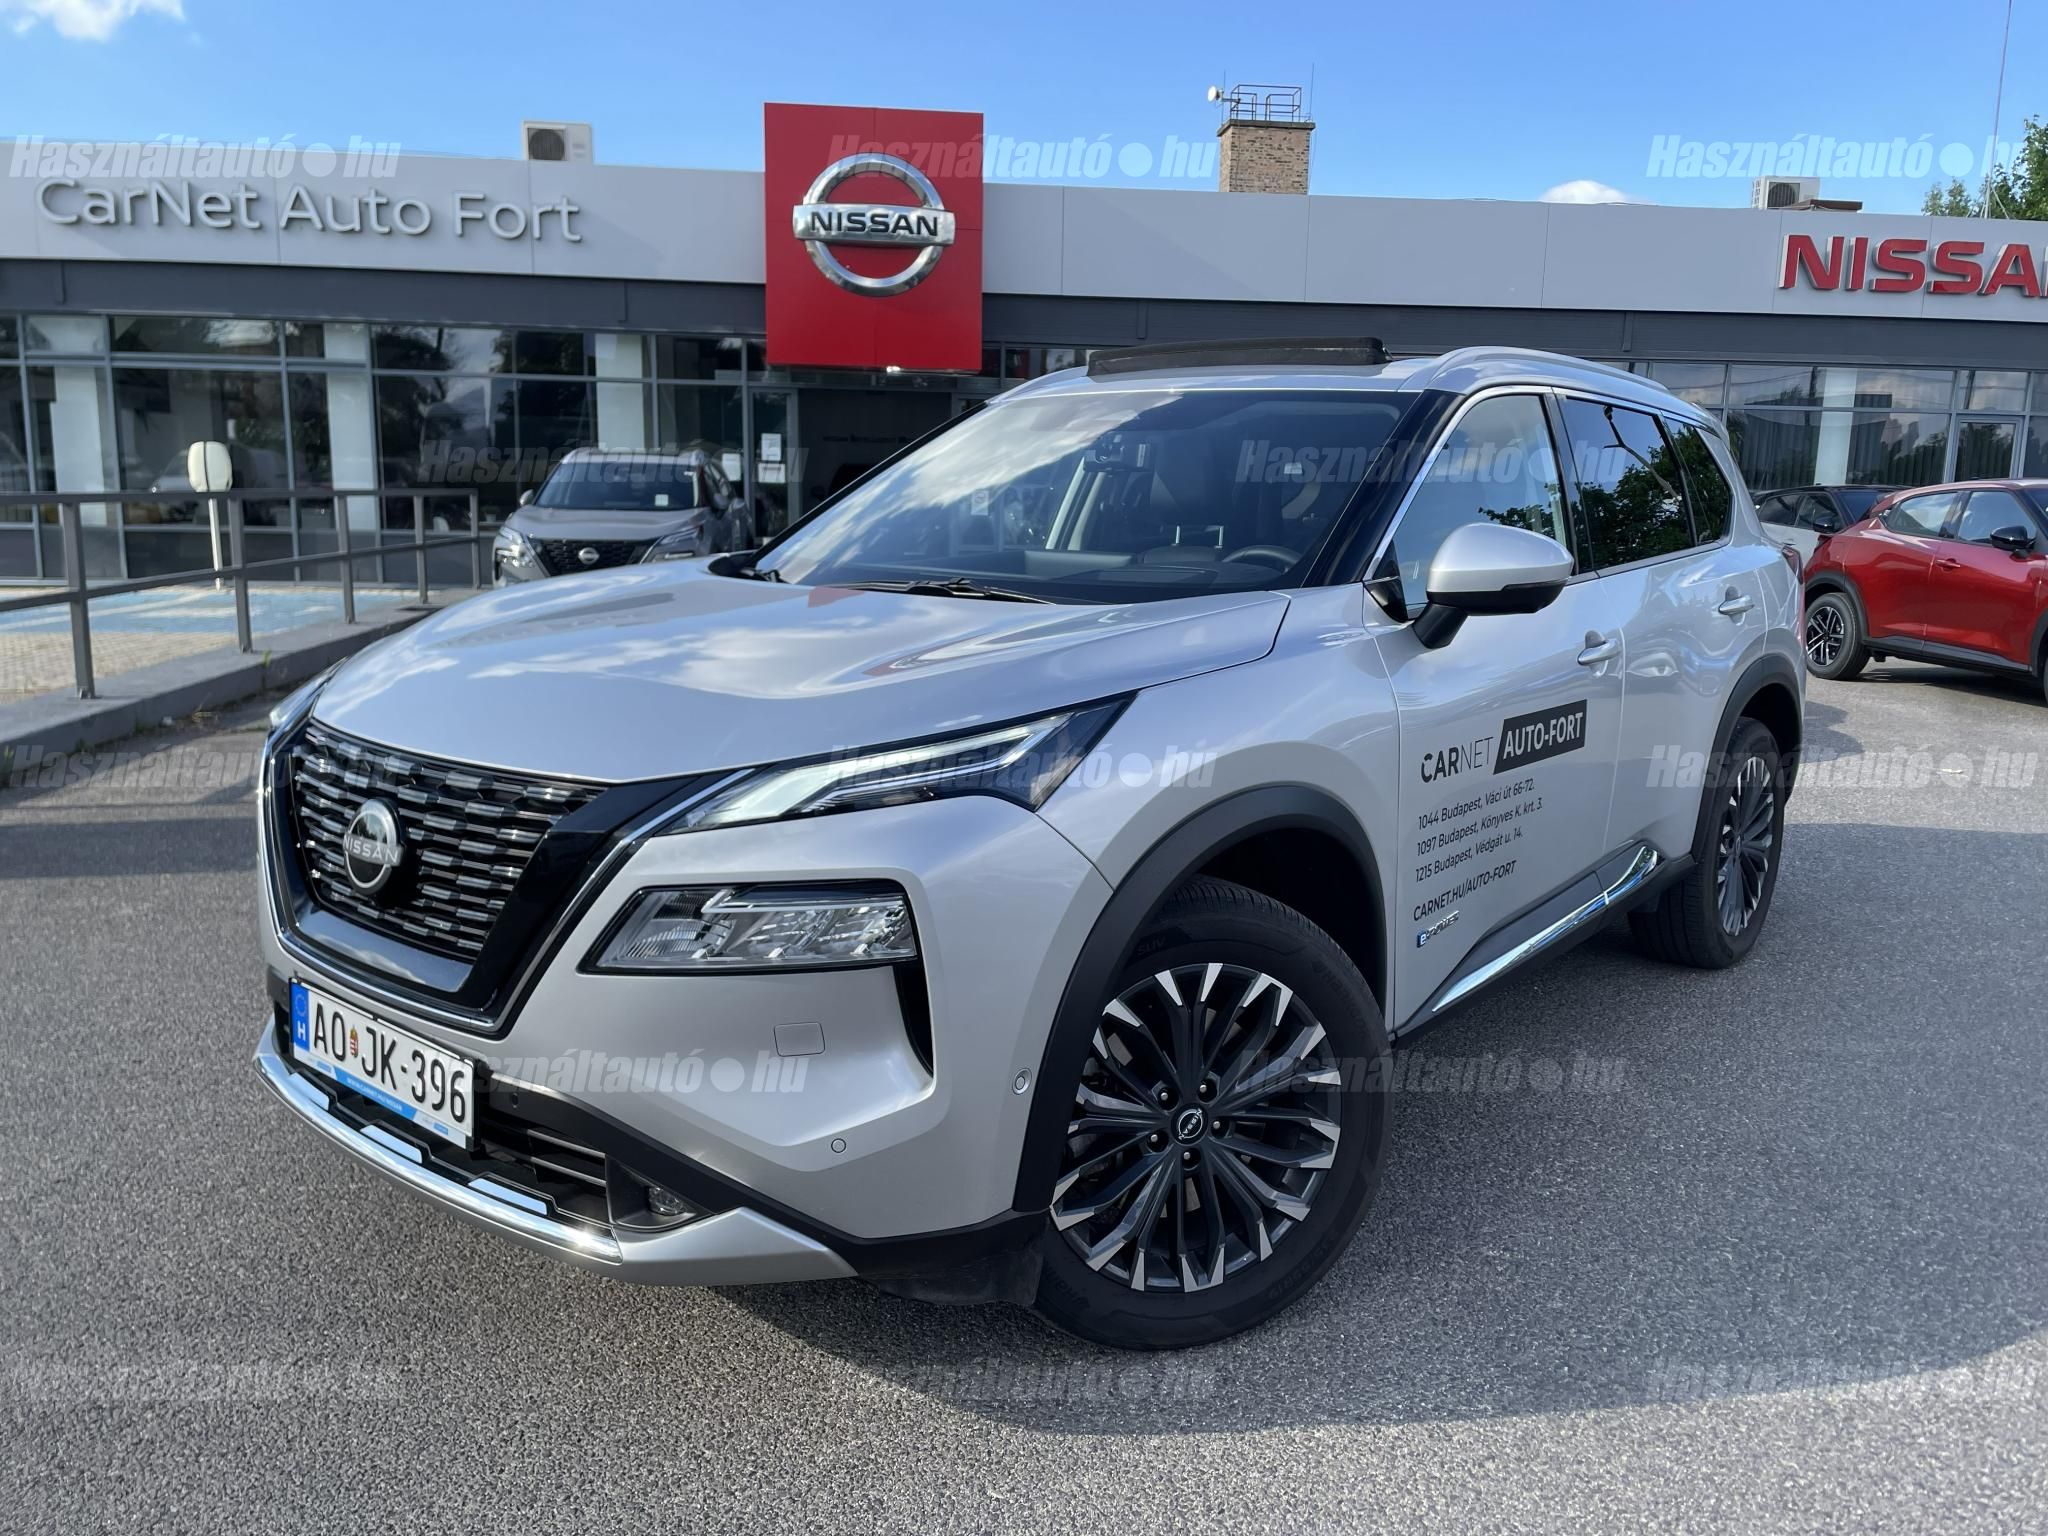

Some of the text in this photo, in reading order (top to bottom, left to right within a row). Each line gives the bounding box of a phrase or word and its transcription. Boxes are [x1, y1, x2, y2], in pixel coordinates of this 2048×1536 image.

[38, 178, 582, 242] CarNet Auto Fort
[810, 211, 938, 237] NISSAN
[1778, 234, 2048, 297] NISSA
[1420, 712, 1583, 783] CARNET AUTO-FORT
[1419, 810, 1439, 830] 1044
[1441, 797, 1483, 822] Budapest,
[1485, 787, 1502, 806] Váci
[343, 834, 398, 863] NISSAN
[1417, 836, 1436, 856] 1097
[1439, 822, 1478, 847] Budapest,
[1480, 809, 1513, 830] Könyves
[1416, 863, 1432, 883] 1215
[1434, 847, 1473, 874] Budapest,
[1413, 860, 1517, 921] CARNET.HU/AUTO-FORT
[297, 1020, 306, 1041] H
